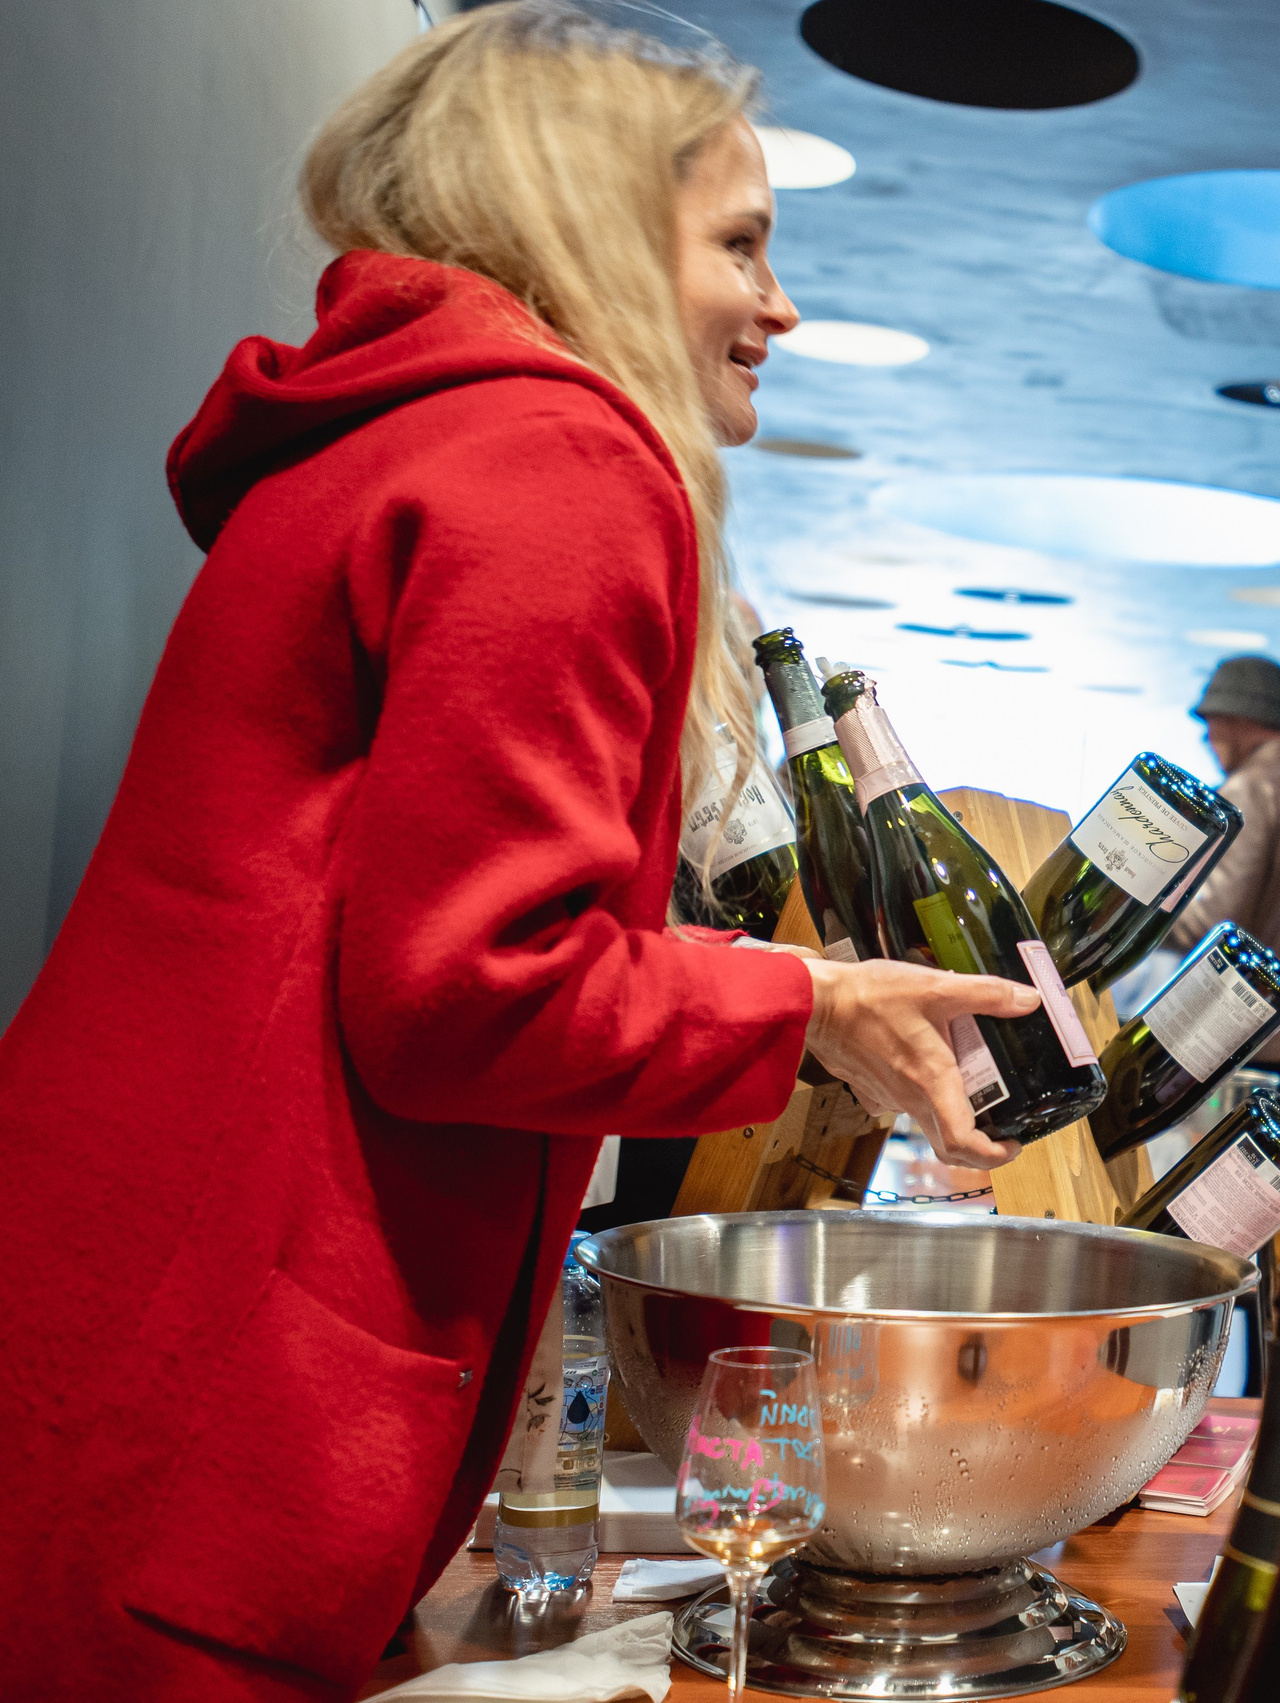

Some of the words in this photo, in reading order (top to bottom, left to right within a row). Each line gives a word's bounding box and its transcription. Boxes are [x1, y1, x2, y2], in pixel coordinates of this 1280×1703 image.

[1137, 785, 1162, 809] PRESTIGE
[1160, 807, 1170, 817] DE
[1110, 786, 1189, 863] Chardonnay
[1169, 814, 1188, 832] CUVEE
